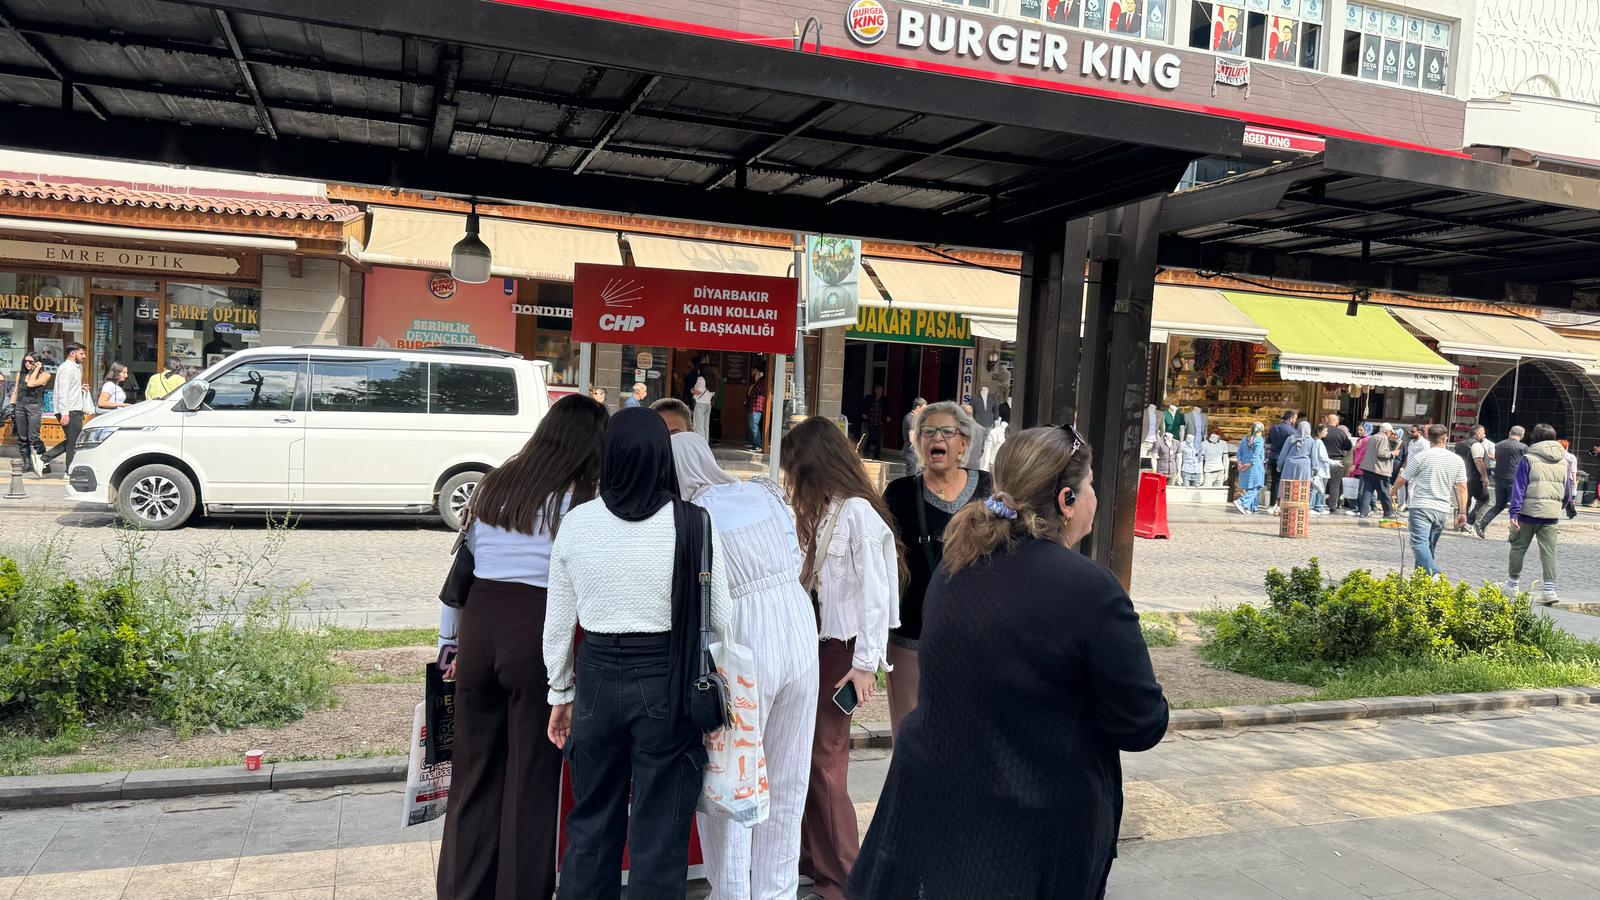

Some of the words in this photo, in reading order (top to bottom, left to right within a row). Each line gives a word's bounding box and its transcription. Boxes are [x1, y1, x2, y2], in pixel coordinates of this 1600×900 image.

[852, 7, 883, 18] BURGER
[852, 15, 884, 30] KING
[898, 8, 1068, 70] BURGER
[1081, 40, 1181, 90] KING
[1363, 61, 1377, 69] DEVA
[1383, 64, 1397, 73] DEVA
[1403, 69, 1417, 77] DEVA
[1427, 72, 1441, 80] DEVA
[1268, 135, 1291, 148] KING
[46, 247, 105, 263] EMRE
[118, 252, 184, 268] OPTİK
[432, 283, 454, 293] KING
[693, 286, 769, 303] DİYARBAKIR
[33, 293, 79, 313] OPTİK
[169, 303, 208, 320] EMRE
[212, 303, 258, 325] OPTİK
[683, 303, 723, 317] KADIN
[726, 306, 778, 321] KOLLARI
[413, 319, 471, 334] SERİNLİK
[599, 314, 646, 332] CHP
[685, 318, 697, 332] İL
[699, 320, 775, 337] BAŞKANLIĞI
[915, 308, 971, 340] PASAJI
[406, 330, 459, 344] DEYİNCE
[459, 334, 477, 345] DE
